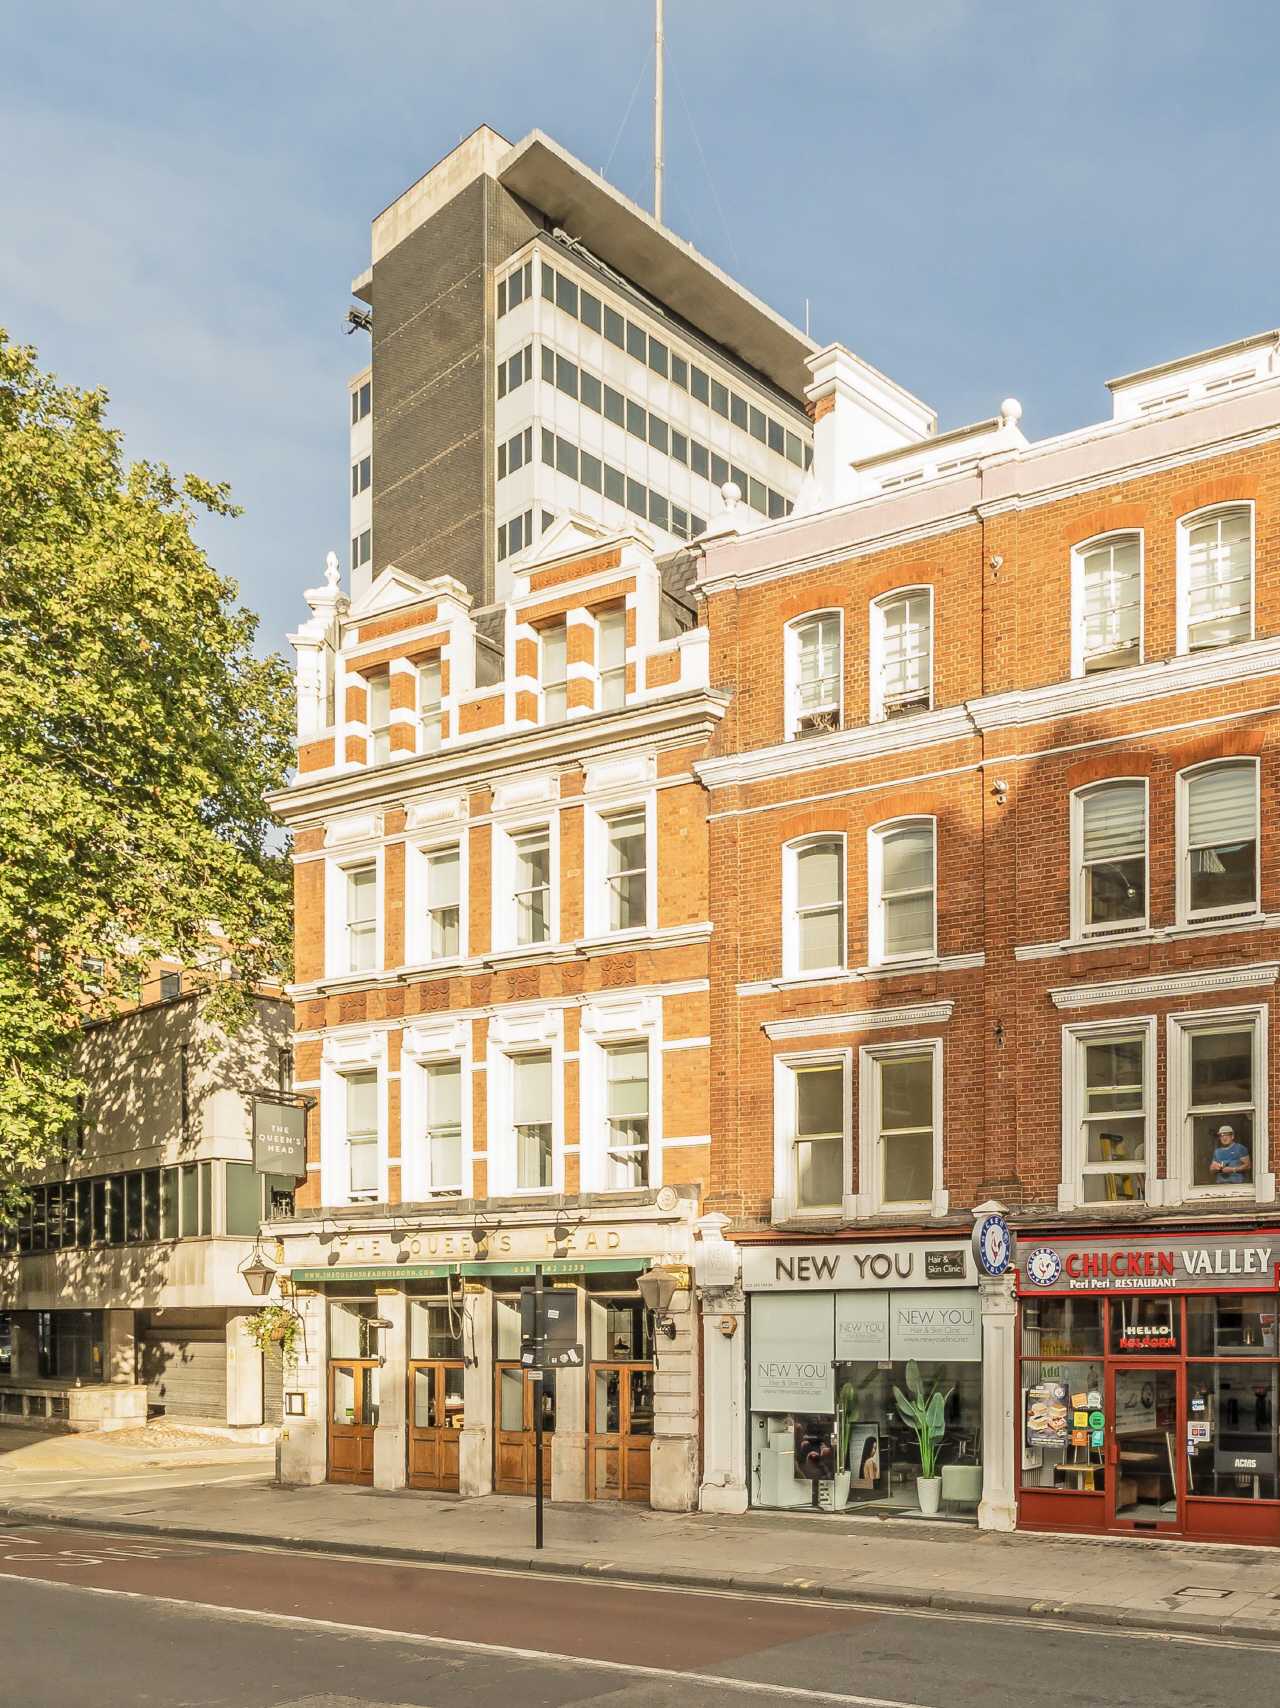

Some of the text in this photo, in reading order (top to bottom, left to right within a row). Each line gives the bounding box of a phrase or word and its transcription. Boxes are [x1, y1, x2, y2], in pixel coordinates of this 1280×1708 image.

[271, 1125, 289, 1134] THE
[258, 1134, 301, 1146] QUEEN'S
[267, 1145, 294, 1154] HEAD
[927, 1255, 950, 1264] Hair &
[1065, 1251, 1175, 1278] CHICKEN
[1181, 1248, 1272, 1275] VALLEY
[775, 1252, 914, 1281] NEW YOU
[927, 1264, 961, 1273] Skin Clinic
[1069, 1278, 1178, 1289] Peri Peri RESTAURANT
[899, 1309, 974, 1324] NEW YOU
[1127, 1326, 1169, 1335] HELLO
[760, 1363, 826, 1378] NEW YOU
